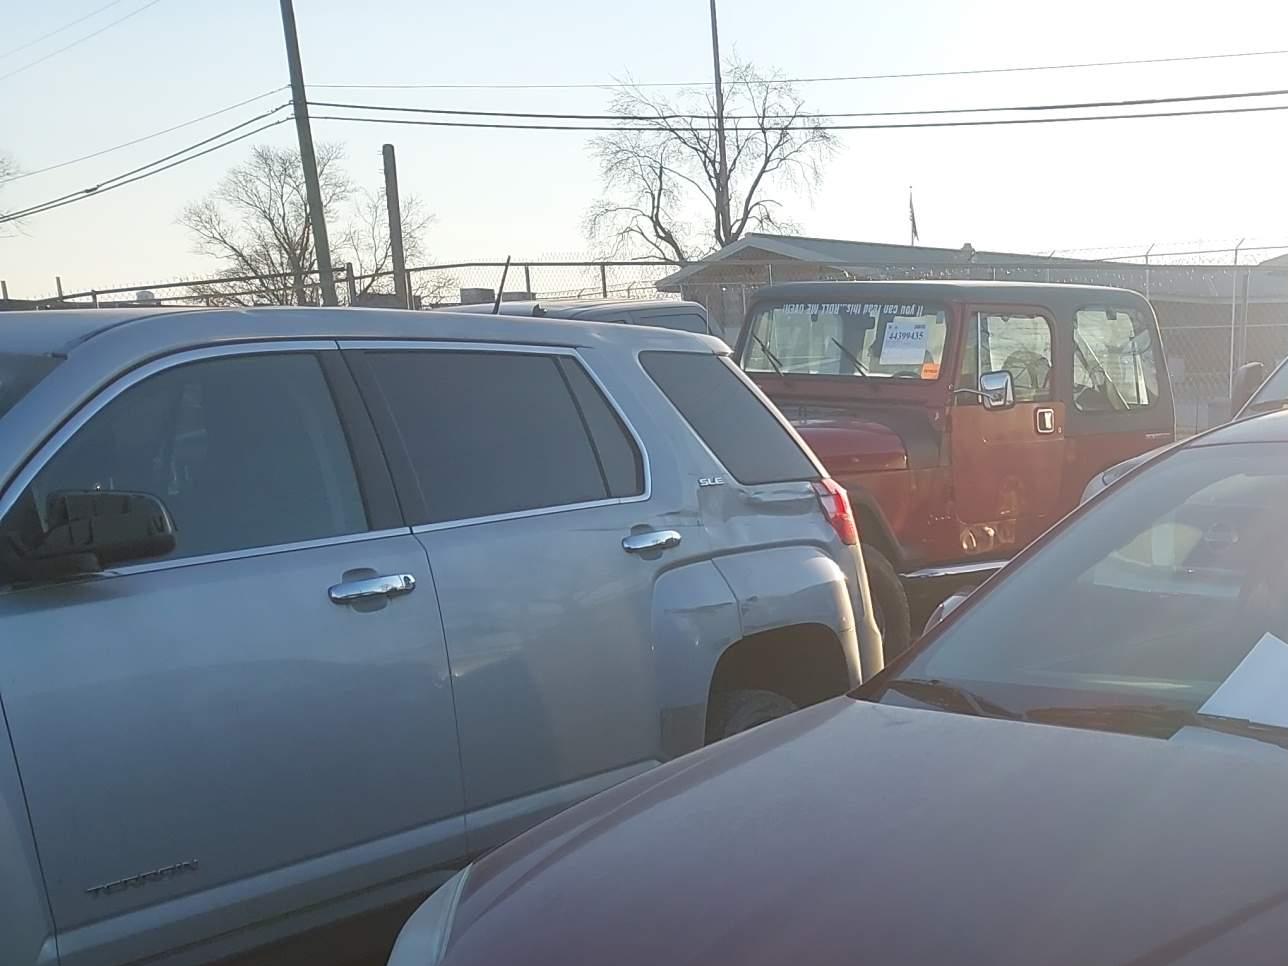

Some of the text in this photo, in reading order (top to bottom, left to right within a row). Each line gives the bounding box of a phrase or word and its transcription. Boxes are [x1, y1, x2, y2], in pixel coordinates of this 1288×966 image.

[862, 303, 882, 315] read
[883, 304, 899, 315] can
[900, 304, 916, 316] you
[699, 476, 725, 487] SLE
